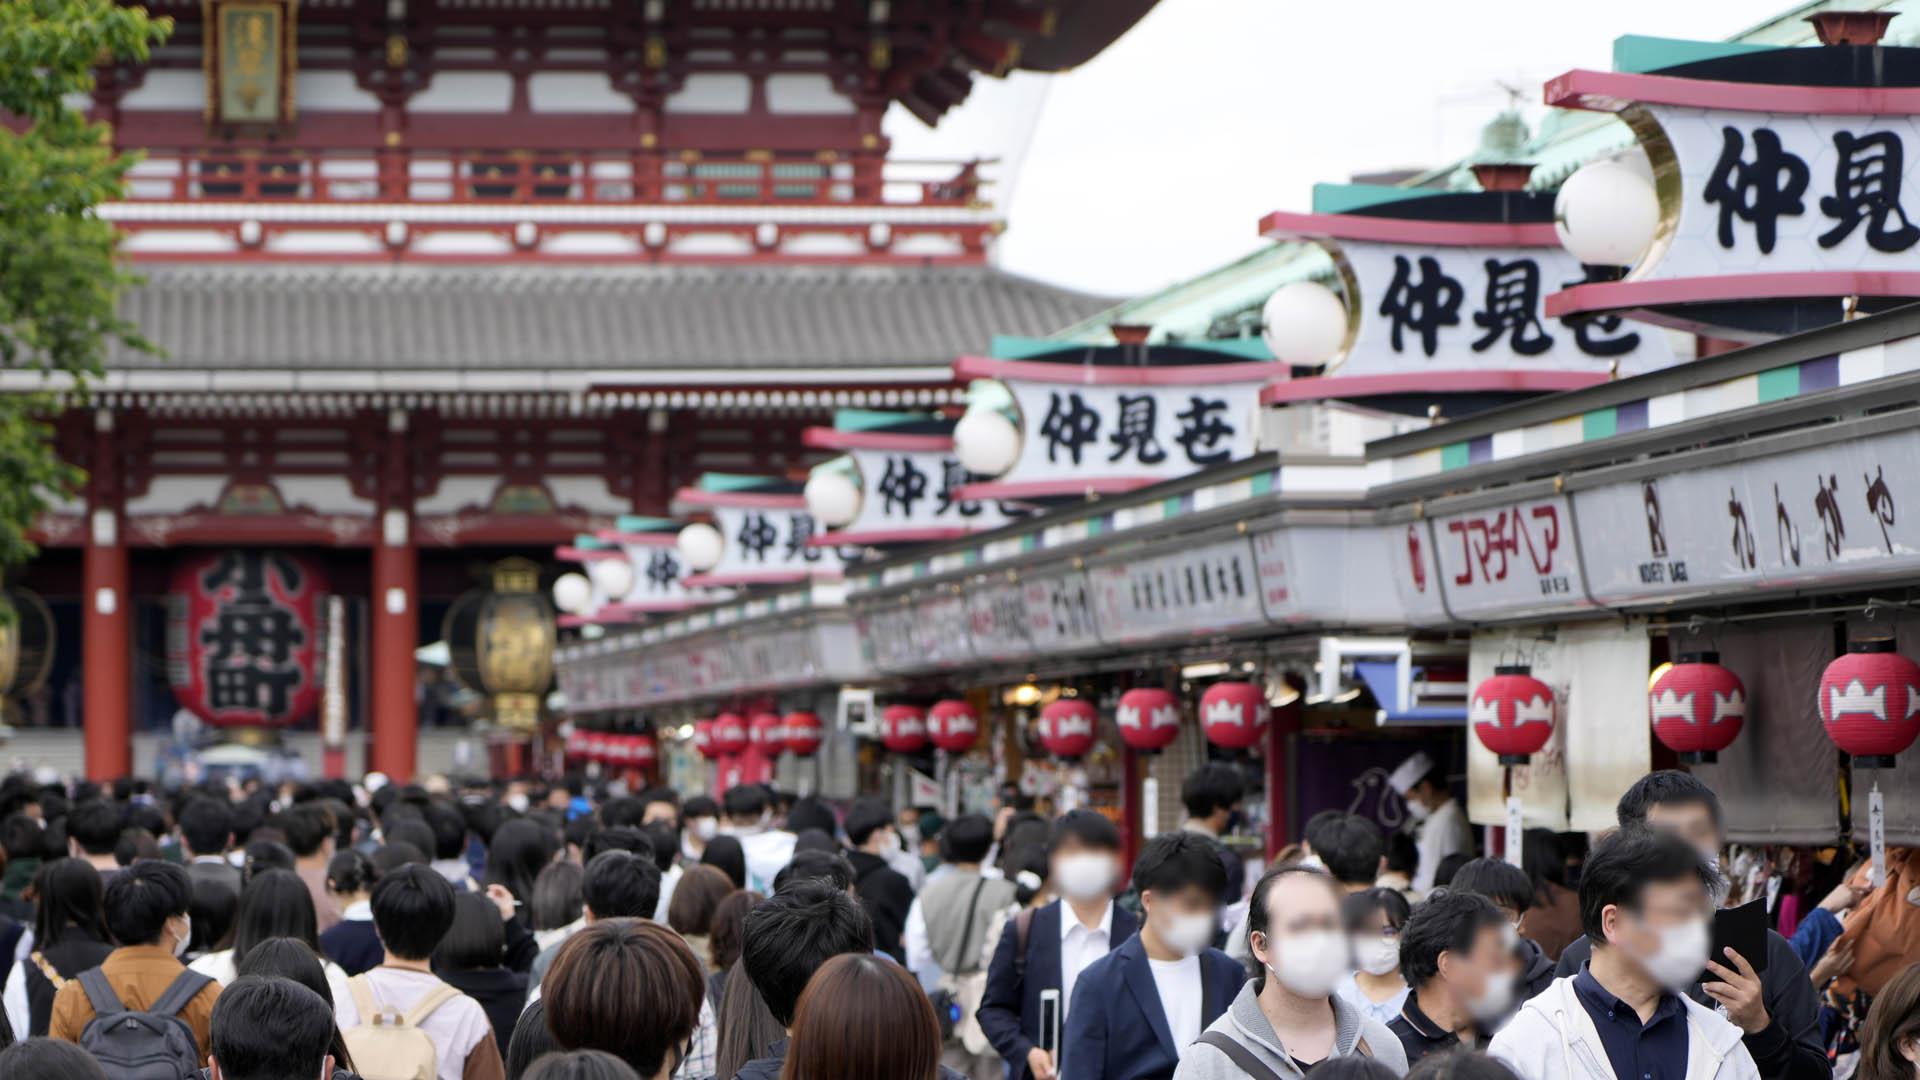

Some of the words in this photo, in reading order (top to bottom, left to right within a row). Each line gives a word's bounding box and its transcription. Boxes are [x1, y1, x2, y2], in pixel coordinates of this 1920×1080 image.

[1728, 464, 1895, 570] れんがや
[202, 554, 304, 716] 小舟町
